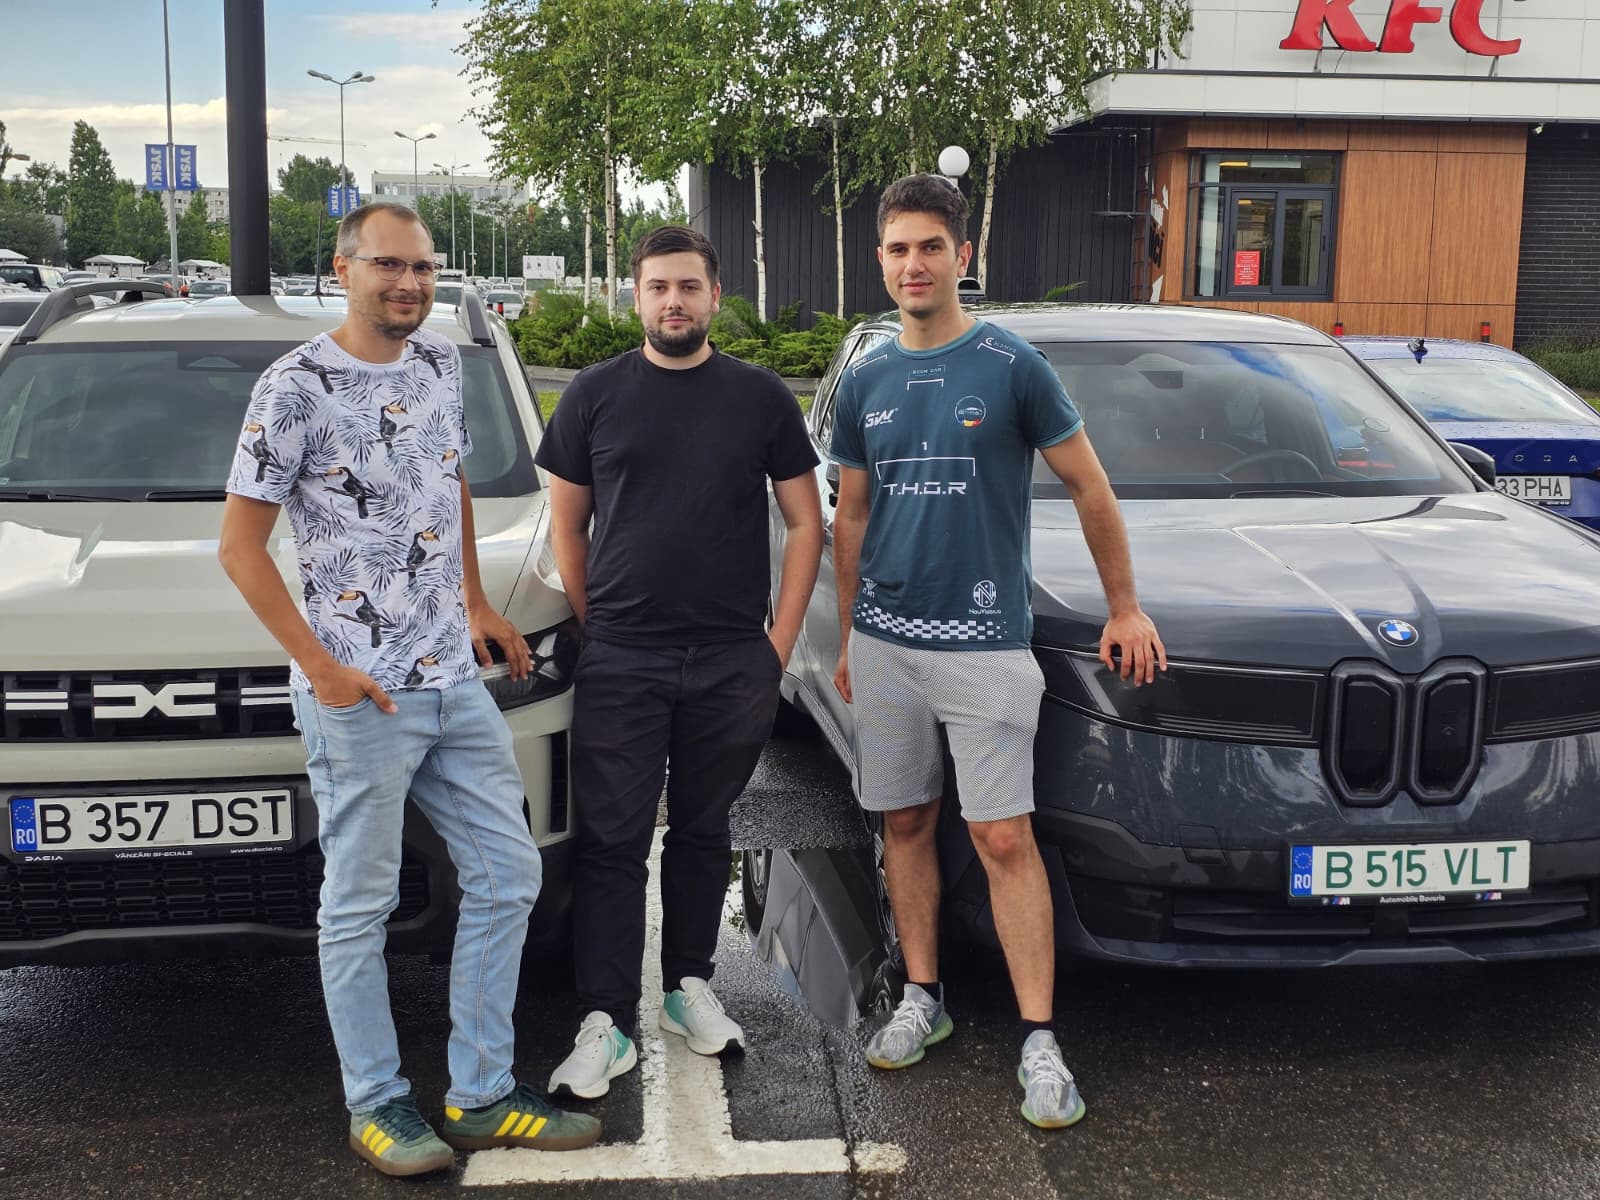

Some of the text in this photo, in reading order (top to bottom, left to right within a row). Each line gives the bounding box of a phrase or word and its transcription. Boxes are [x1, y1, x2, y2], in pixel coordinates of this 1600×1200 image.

[1279, 0, 1522, 56] KFC
[921, 441, 927, 451] 1
[1525, 478, 1563, 497] PHA
[39, 795, 287, 844] B 357 DST
[16, 828, 36, 845] RO
[1326, 846, 1518, 889] B 515 VLT
[1294, 874, 1311, 889] RO
